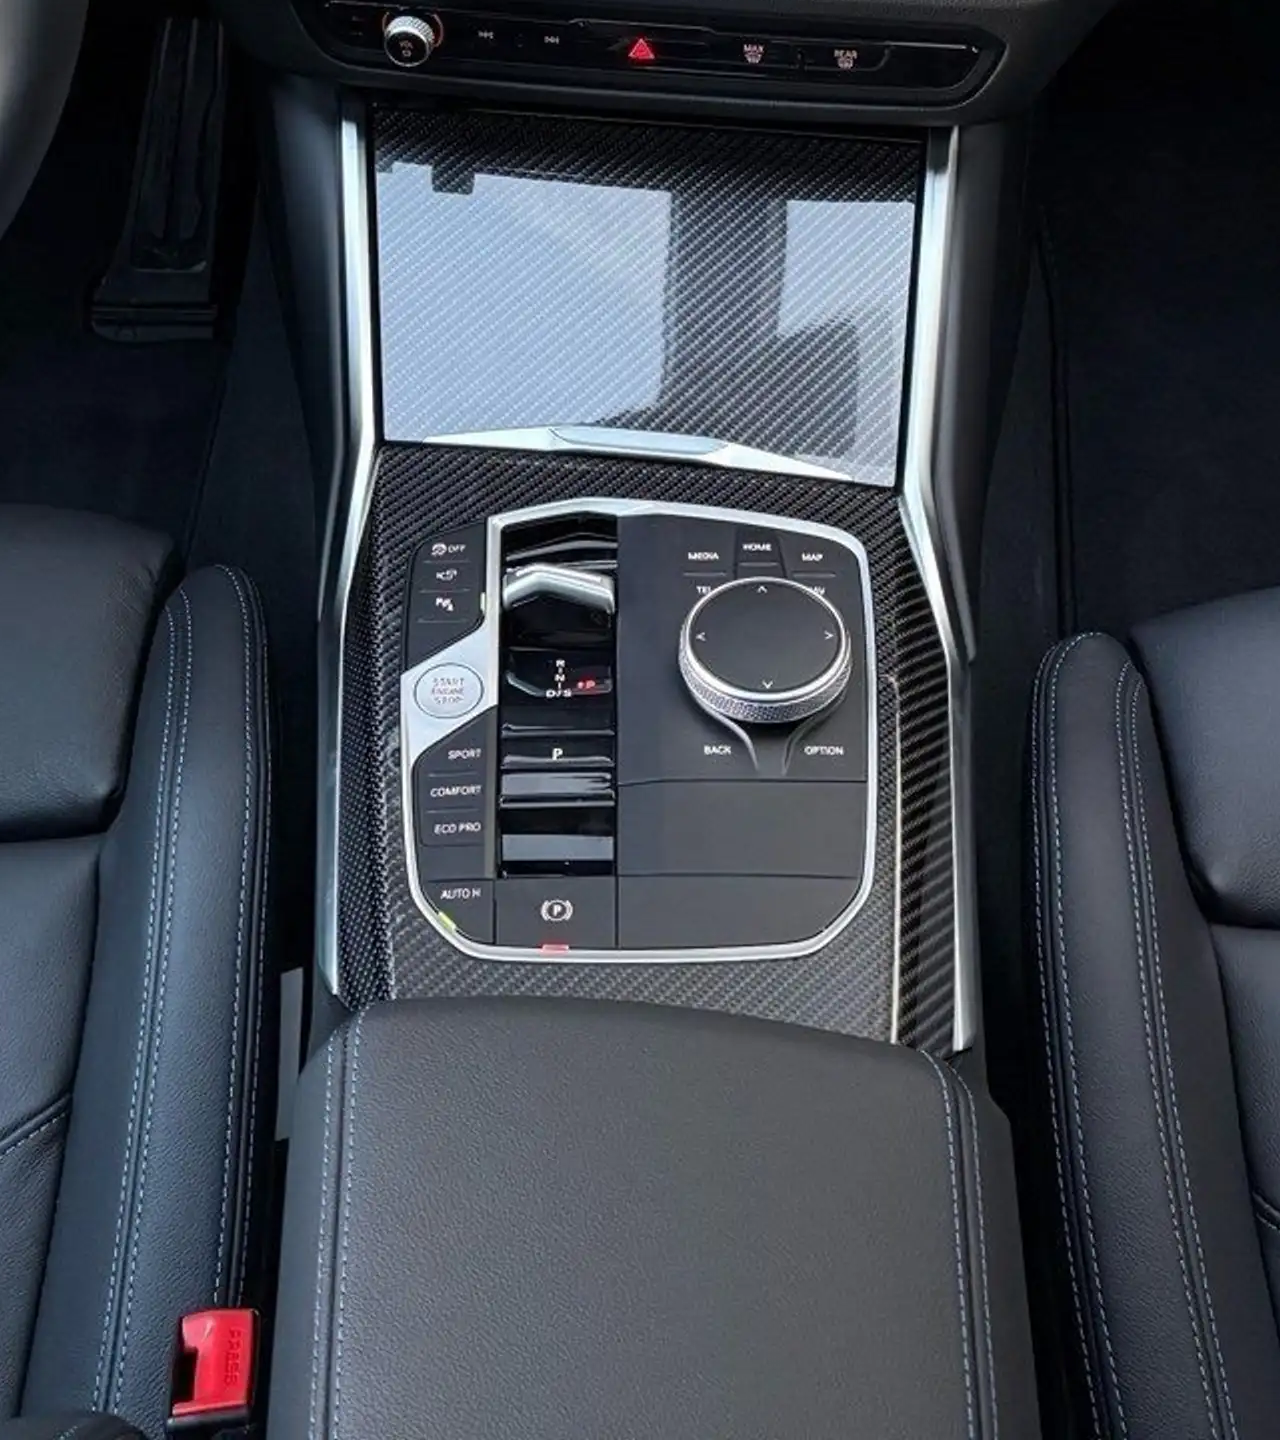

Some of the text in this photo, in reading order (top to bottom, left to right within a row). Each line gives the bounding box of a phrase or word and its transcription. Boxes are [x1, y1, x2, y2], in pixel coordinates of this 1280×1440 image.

[447, 544, 467, 554] OFF
[742, 543, 772, 551] HOME
[687, 552, 719, 560] MEDIA
[801, 553, 824, 561] MAP
[432, 678, 465, 687] START
[448, 747, 481, 760] SPORT
[551, 748, 563, 761] P
[703, 745, 732, 755] BACK
[803, 745, 844, 755] OPTION
[430, 785, 482, 797] COMFORT
[433, 822, 482, 835] ECO PRO
[439, 887, 481, 900] AUTO H
